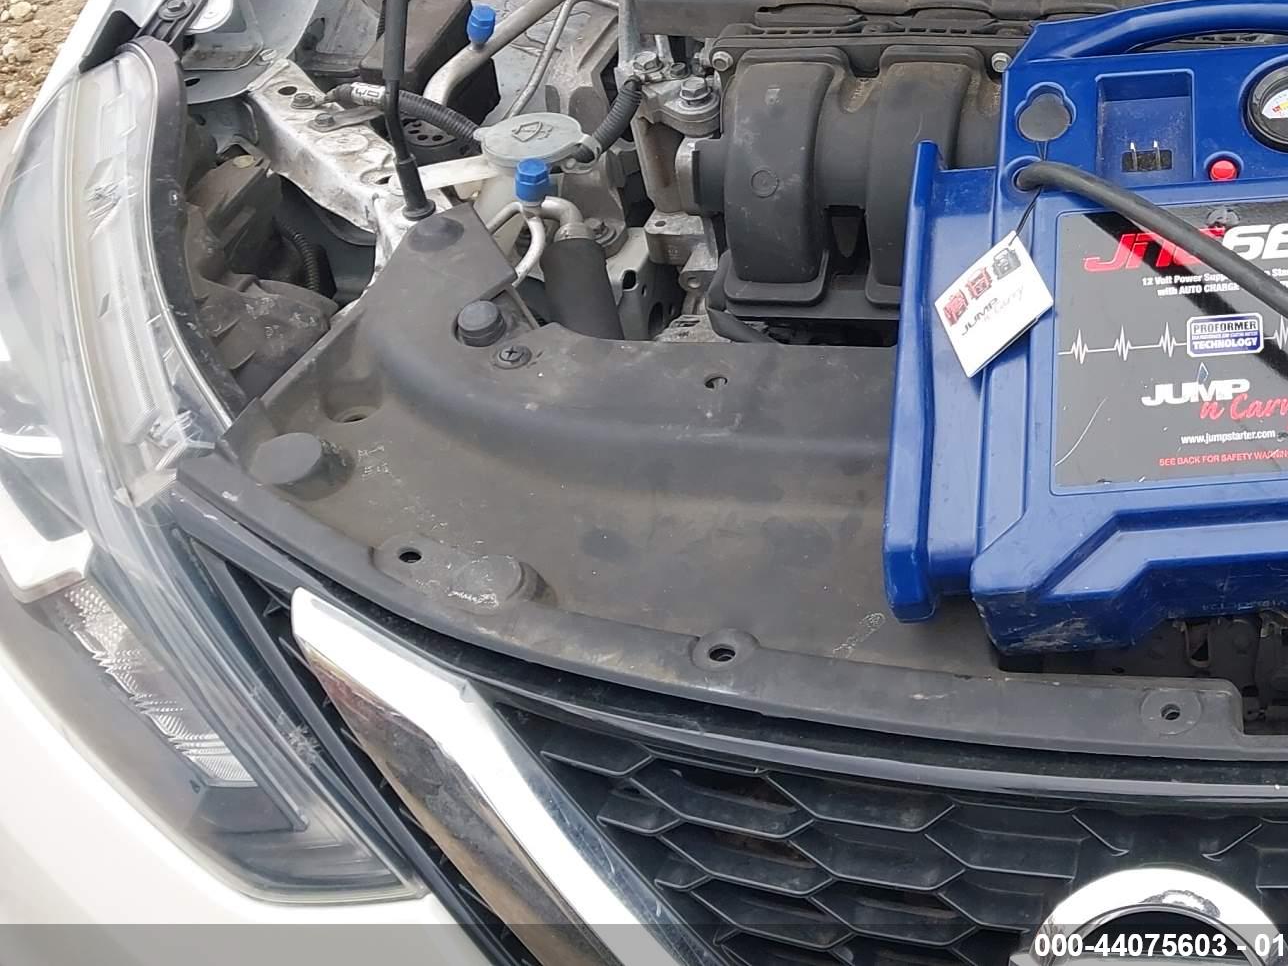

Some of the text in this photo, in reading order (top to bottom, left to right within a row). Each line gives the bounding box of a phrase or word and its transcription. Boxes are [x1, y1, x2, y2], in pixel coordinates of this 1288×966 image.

[1142, 277, 1154, 286] 12
[1154, 275, 1173, 285] Volt
[1173, 274, 1203, 284] Power
[1203, 272, 1229, 283] Supp
[1157, 286, 1178, 296] with
[1178, 284, 1203, 294] AUTO
[1193, 320, 1257, 333] PROFORMER
[1191, 336, 1258, 350] TECHNOLOGY
[1141, 378, 1250, 406] JUMP
[1181, 429, 1276, 445] www.jumpstarter.com
[1159, 457, 1176, 466] SEE
[1177, 456, 1201, 465] BACK
[1202, 455, 1220, 464] FOR
[1221, 452, 1253, 462] SAFETY
